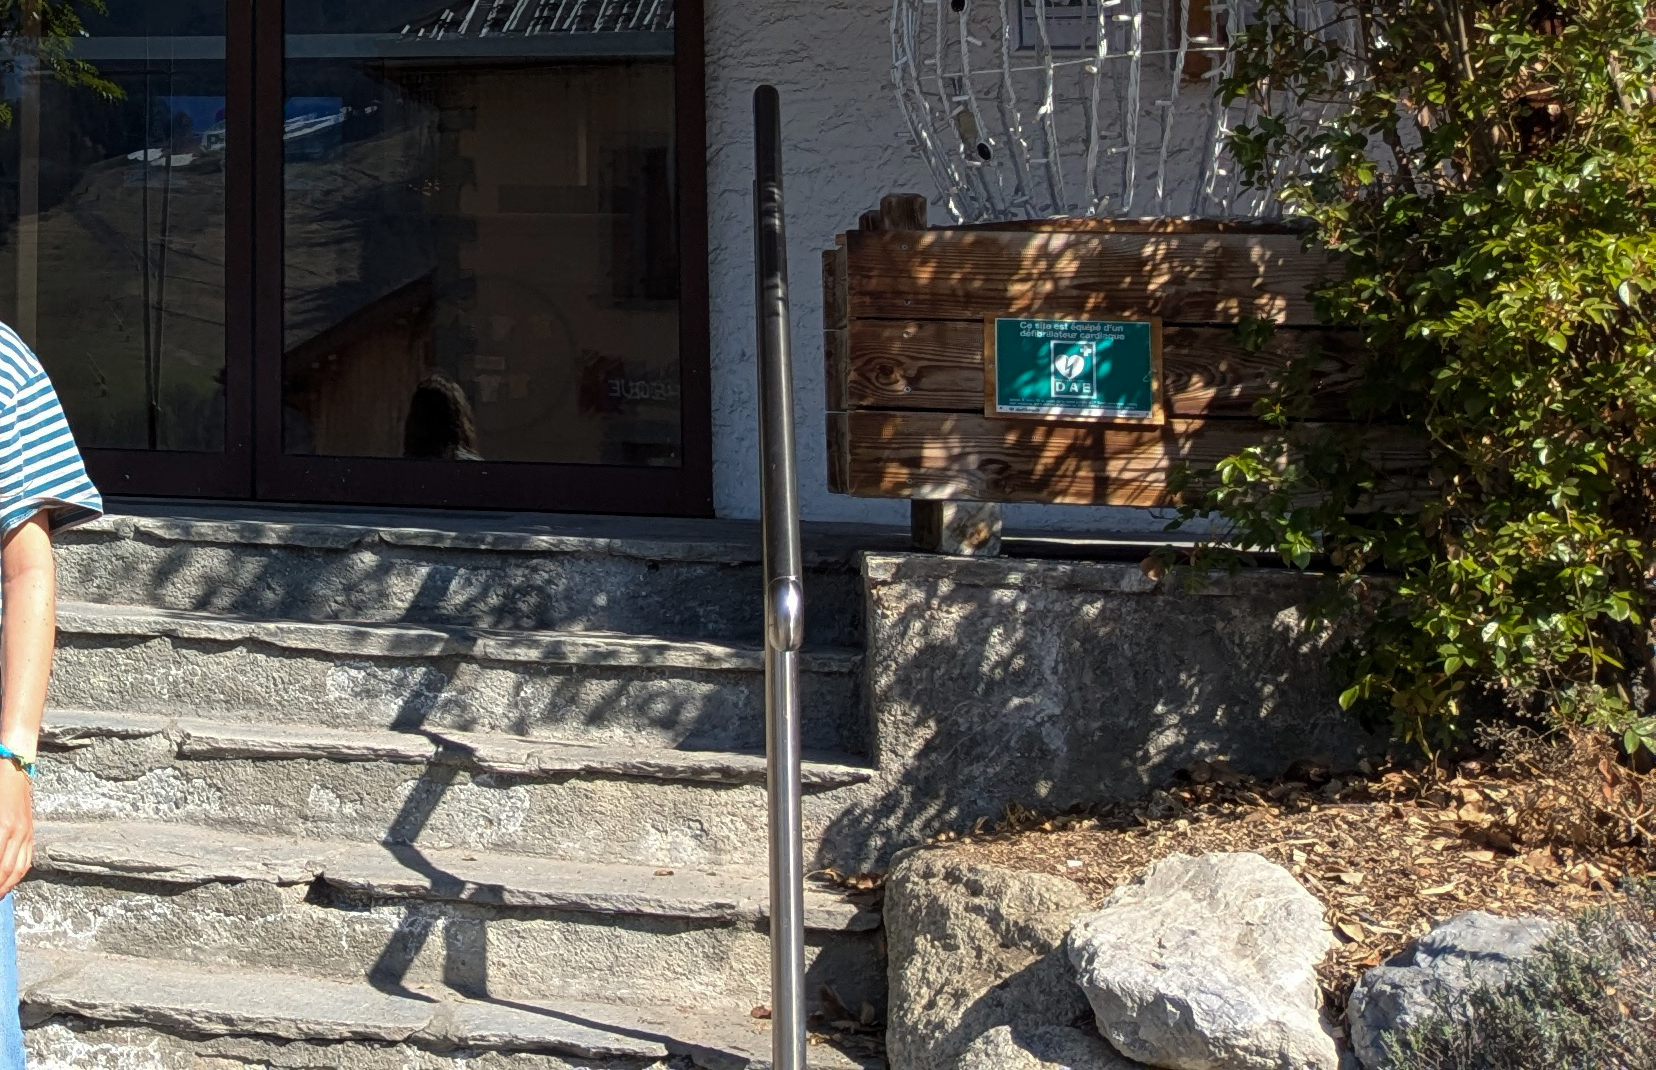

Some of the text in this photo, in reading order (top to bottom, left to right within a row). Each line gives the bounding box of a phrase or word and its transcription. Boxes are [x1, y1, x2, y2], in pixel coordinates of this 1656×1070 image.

[1019, 321, 1033, 330] Ce
[1034, 322, 1052, 330] site
[1053, 322, 1069, 331] est
[1070, 322, 1102, 333] équipé
[1019, 329, 1078, 339] défibrillateur
[1055, 382, 1092, 393] DAE
